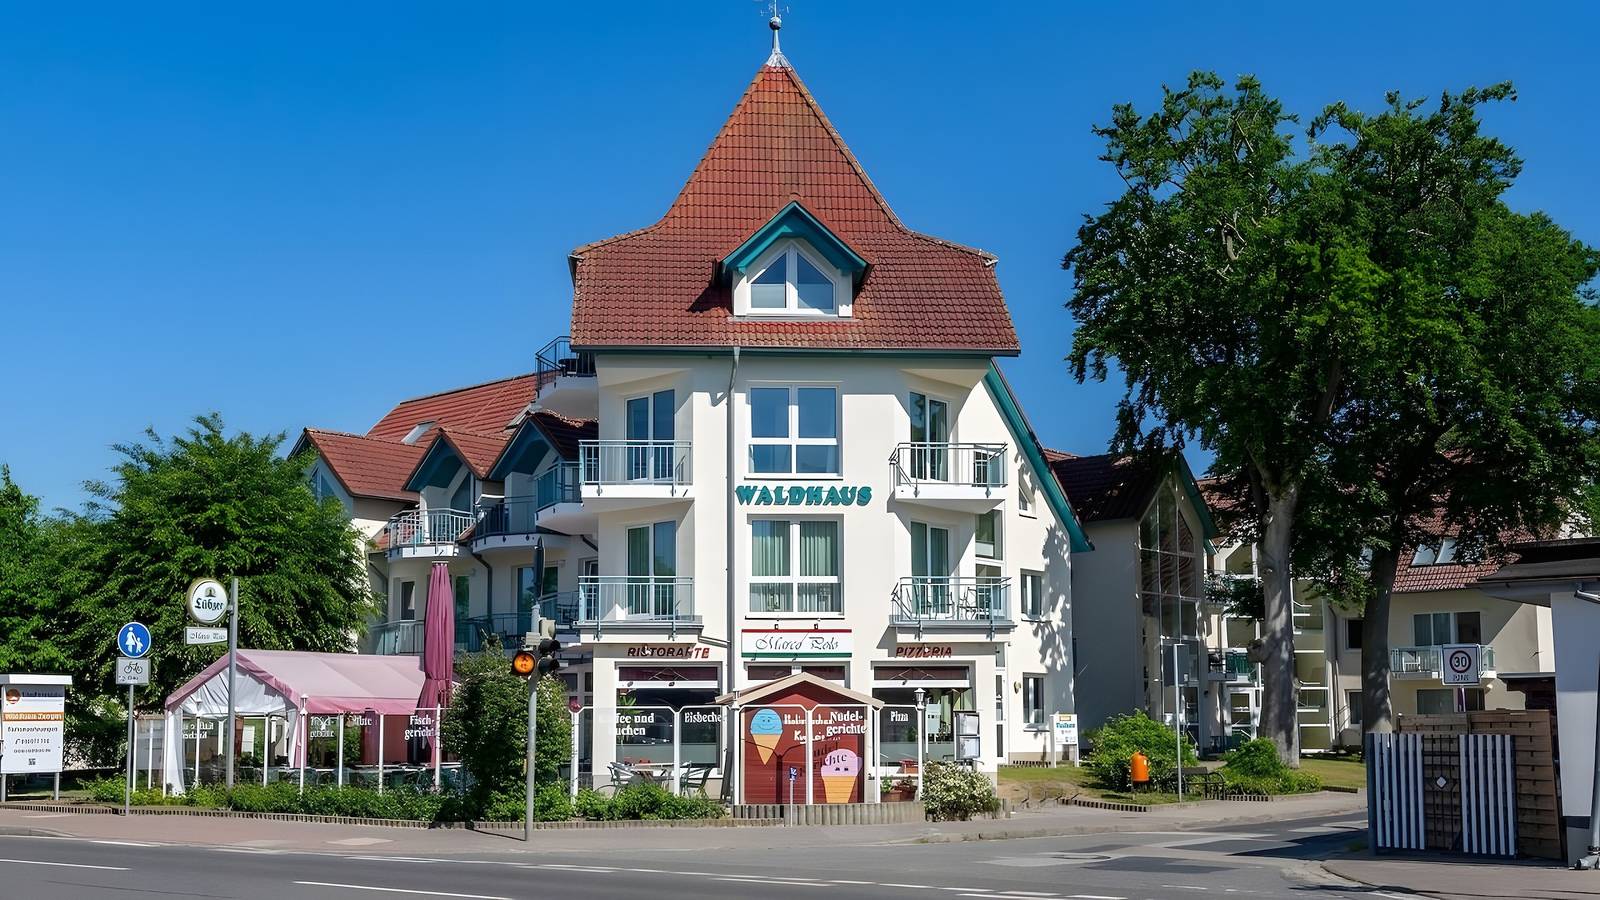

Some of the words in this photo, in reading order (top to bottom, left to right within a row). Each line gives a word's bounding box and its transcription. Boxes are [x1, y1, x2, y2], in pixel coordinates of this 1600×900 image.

[735, 485, 872, 506] WALDHAUS
[755, 636, 808, 650] Marco
[808, 636, 839, 650] Polo
[627, 646, 710, 659] RISTORANTE
[896, 646, 952, 658] PIZZERIA
[1454, 656, 1467, 667] 30
[410, 714, 434, 725] Fisch-
[634, 712, 654, 723] und
[830, 711, 863, 721] Nudel-
[890, 711, 909, 722] Pizza
[404, 727, 438, 740] gericht
[615, 725, 645, 735] uchen
